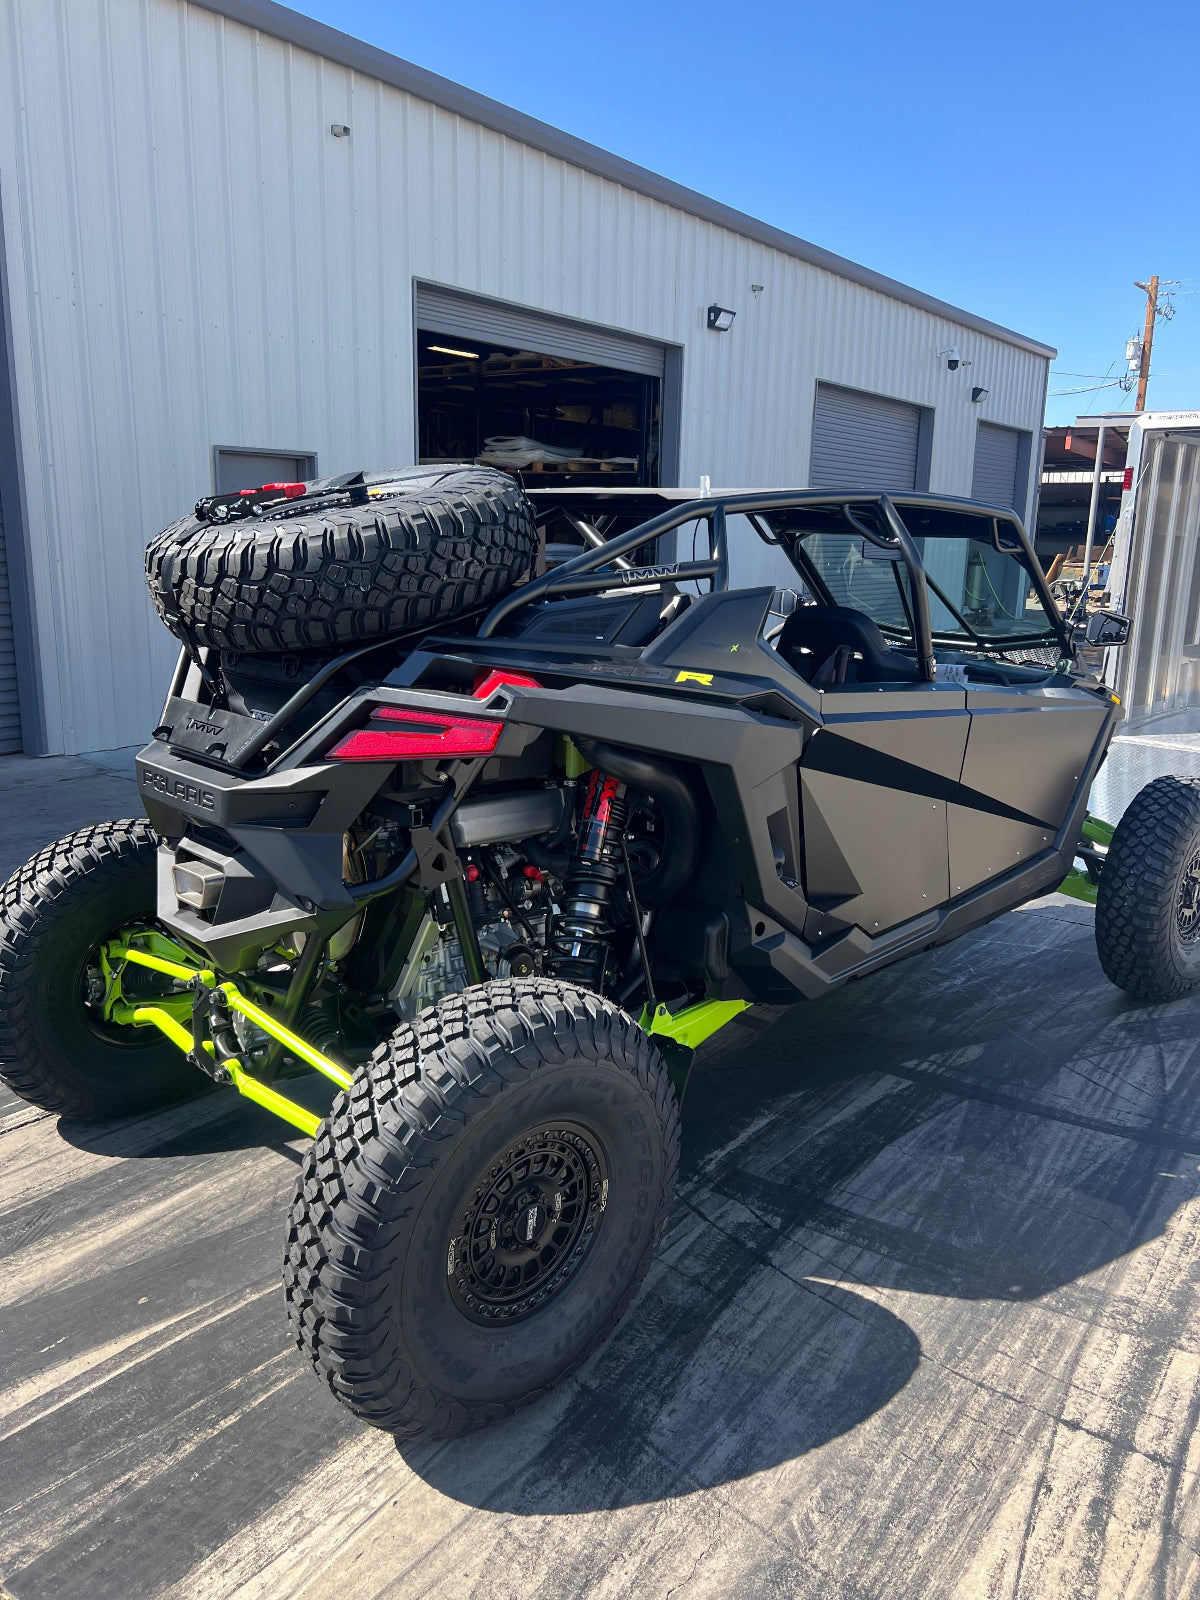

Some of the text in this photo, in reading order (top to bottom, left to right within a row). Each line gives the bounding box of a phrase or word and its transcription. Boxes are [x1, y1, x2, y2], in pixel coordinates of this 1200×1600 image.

[615, 563, 680, 585] TMW
[675, 670, 714, 686] R
[186, 718, 224, 736] TMW
[143, 769, 214, 811] POLARIS
